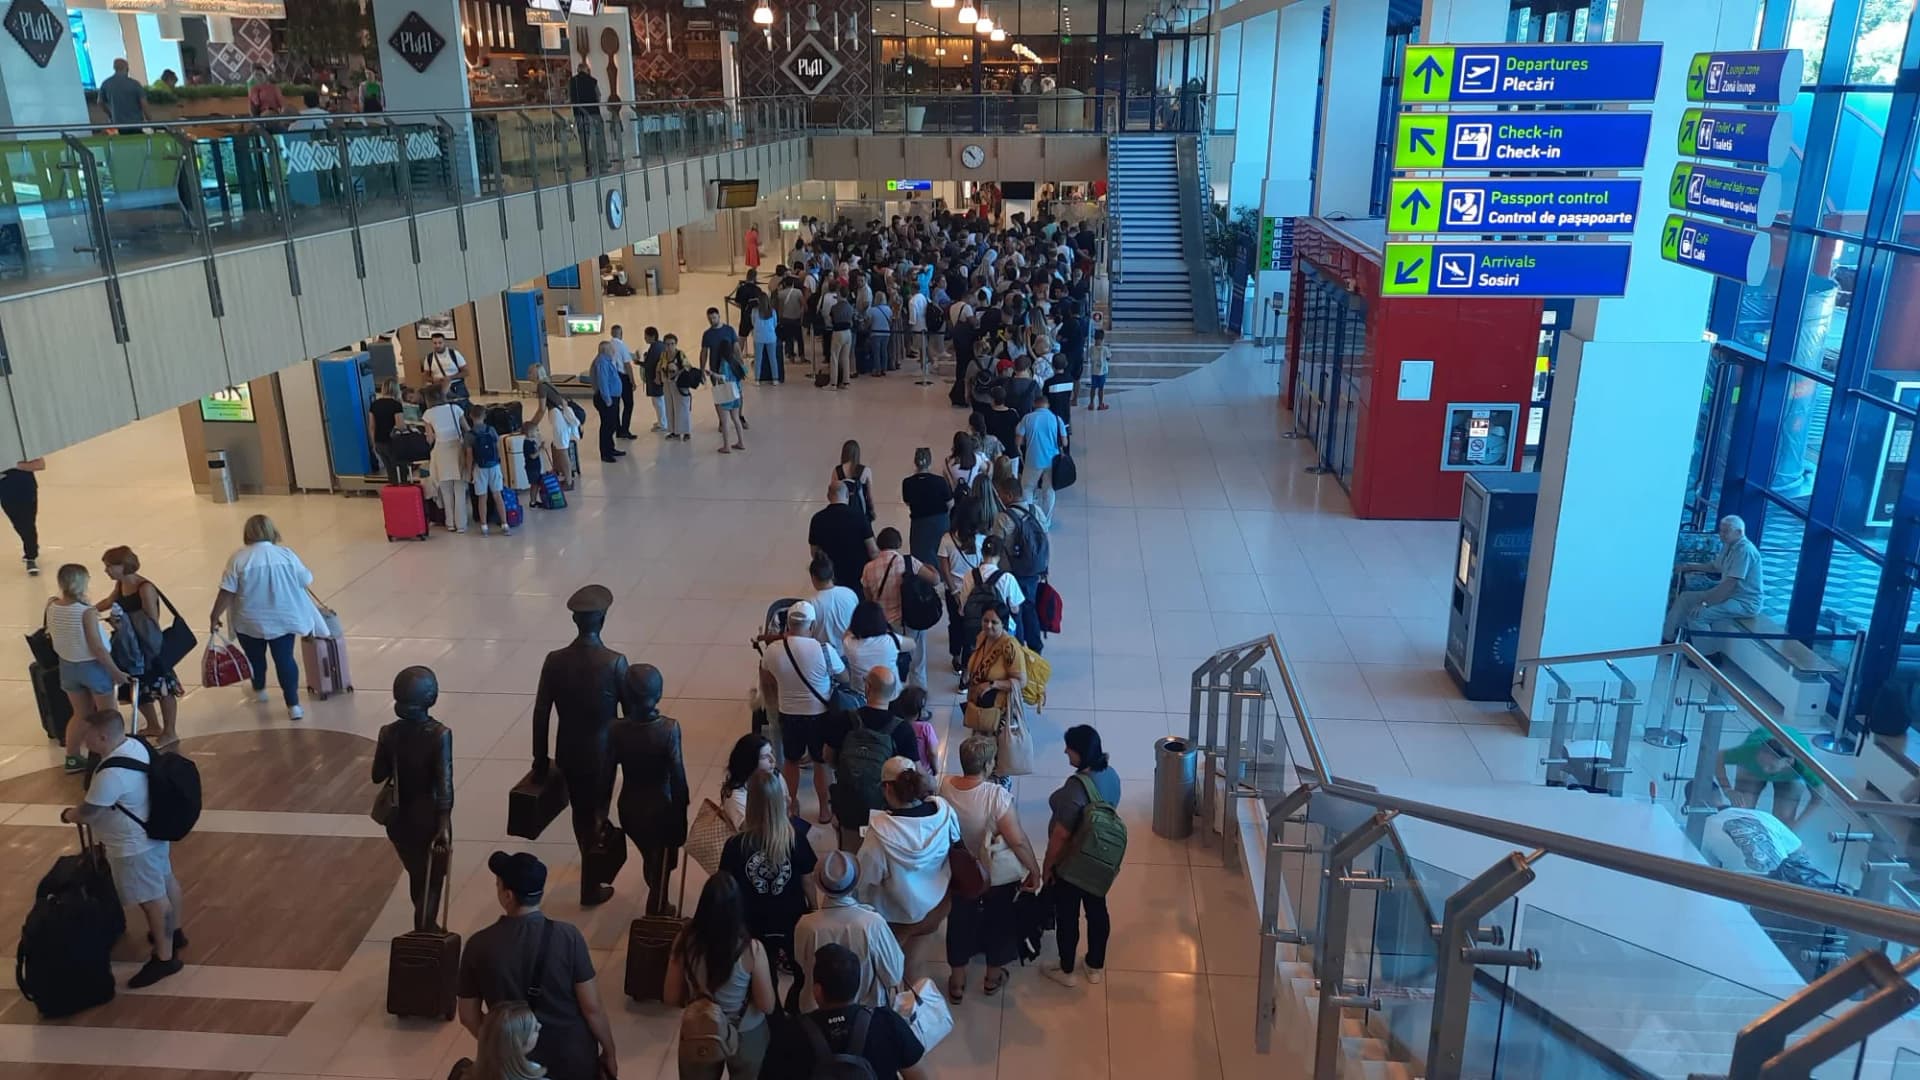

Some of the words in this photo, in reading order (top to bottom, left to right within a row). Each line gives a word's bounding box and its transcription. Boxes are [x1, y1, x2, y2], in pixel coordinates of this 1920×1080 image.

[19, 11, 54, 43] PLAI
[400, 31, 433, 55] PLAI
[798, 58, 823, 77] PLAI
[1506, 57, 1588, 74] Departures
[1503, 77, 1555, 91] Plecări
[1736, 81, 1756, 95] lounge
[1499, 125, 1563, 139] Check-in
[1496, 144, 1561, 158] Check-in
[1491, 191, 1554, 207] Passport
[1558, 191, 1609, 204] control
[1488, 211, 1536, 224] Control
[1539, 211, 1555, 224] de
[1480, 255, 1536, 268] Arrivals
[1478, 273, 1520, 287] Sosiri
